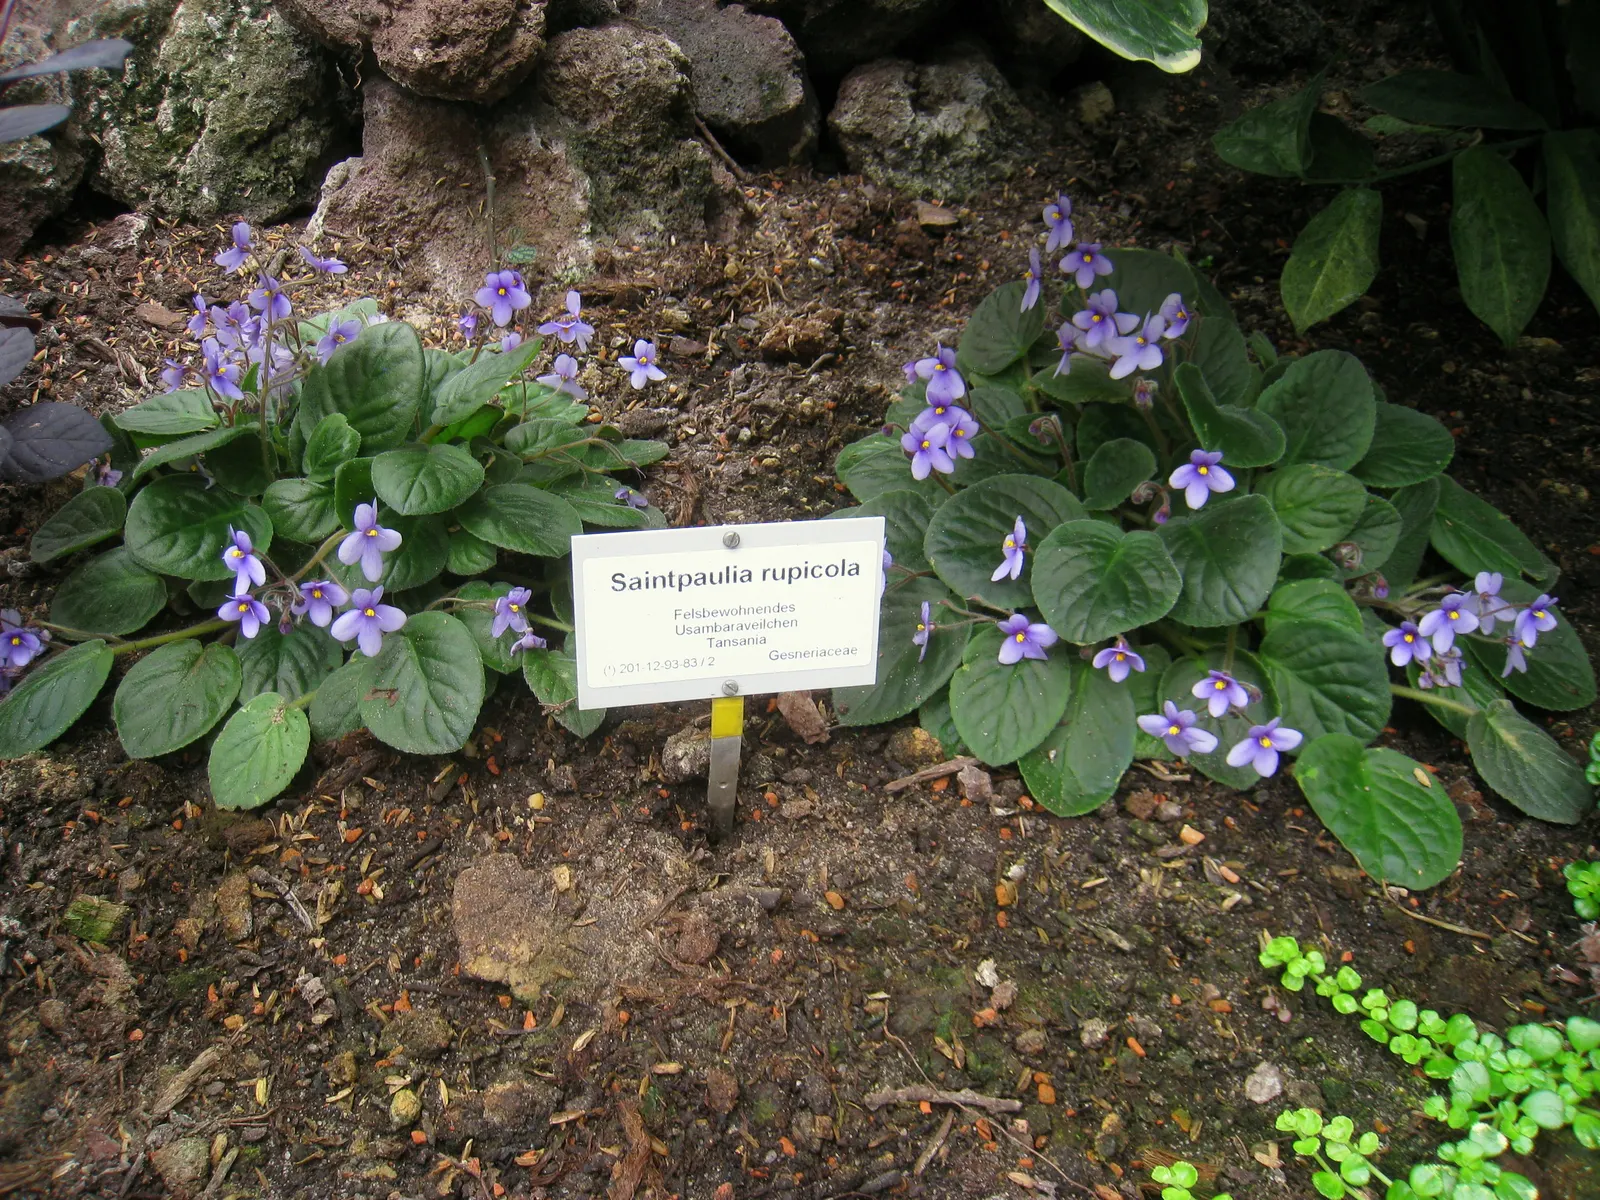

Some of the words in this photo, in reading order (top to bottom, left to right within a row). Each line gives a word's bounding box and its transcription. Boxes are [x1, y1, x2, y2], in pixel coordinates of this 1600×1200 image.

[611, 565, 753, 592] Saintpaulia
[762, 558, 861, 584] rupicola
[674, 602, 796, 620] Felsbewohnendes
[675, 618, 798, 636] Usambaraveilchen
[707, 635, 767, 649] Tansania
[769, 645, 858, 661] Gesneriaceae
[620, 658, 698, 673] 201-12-93-83
